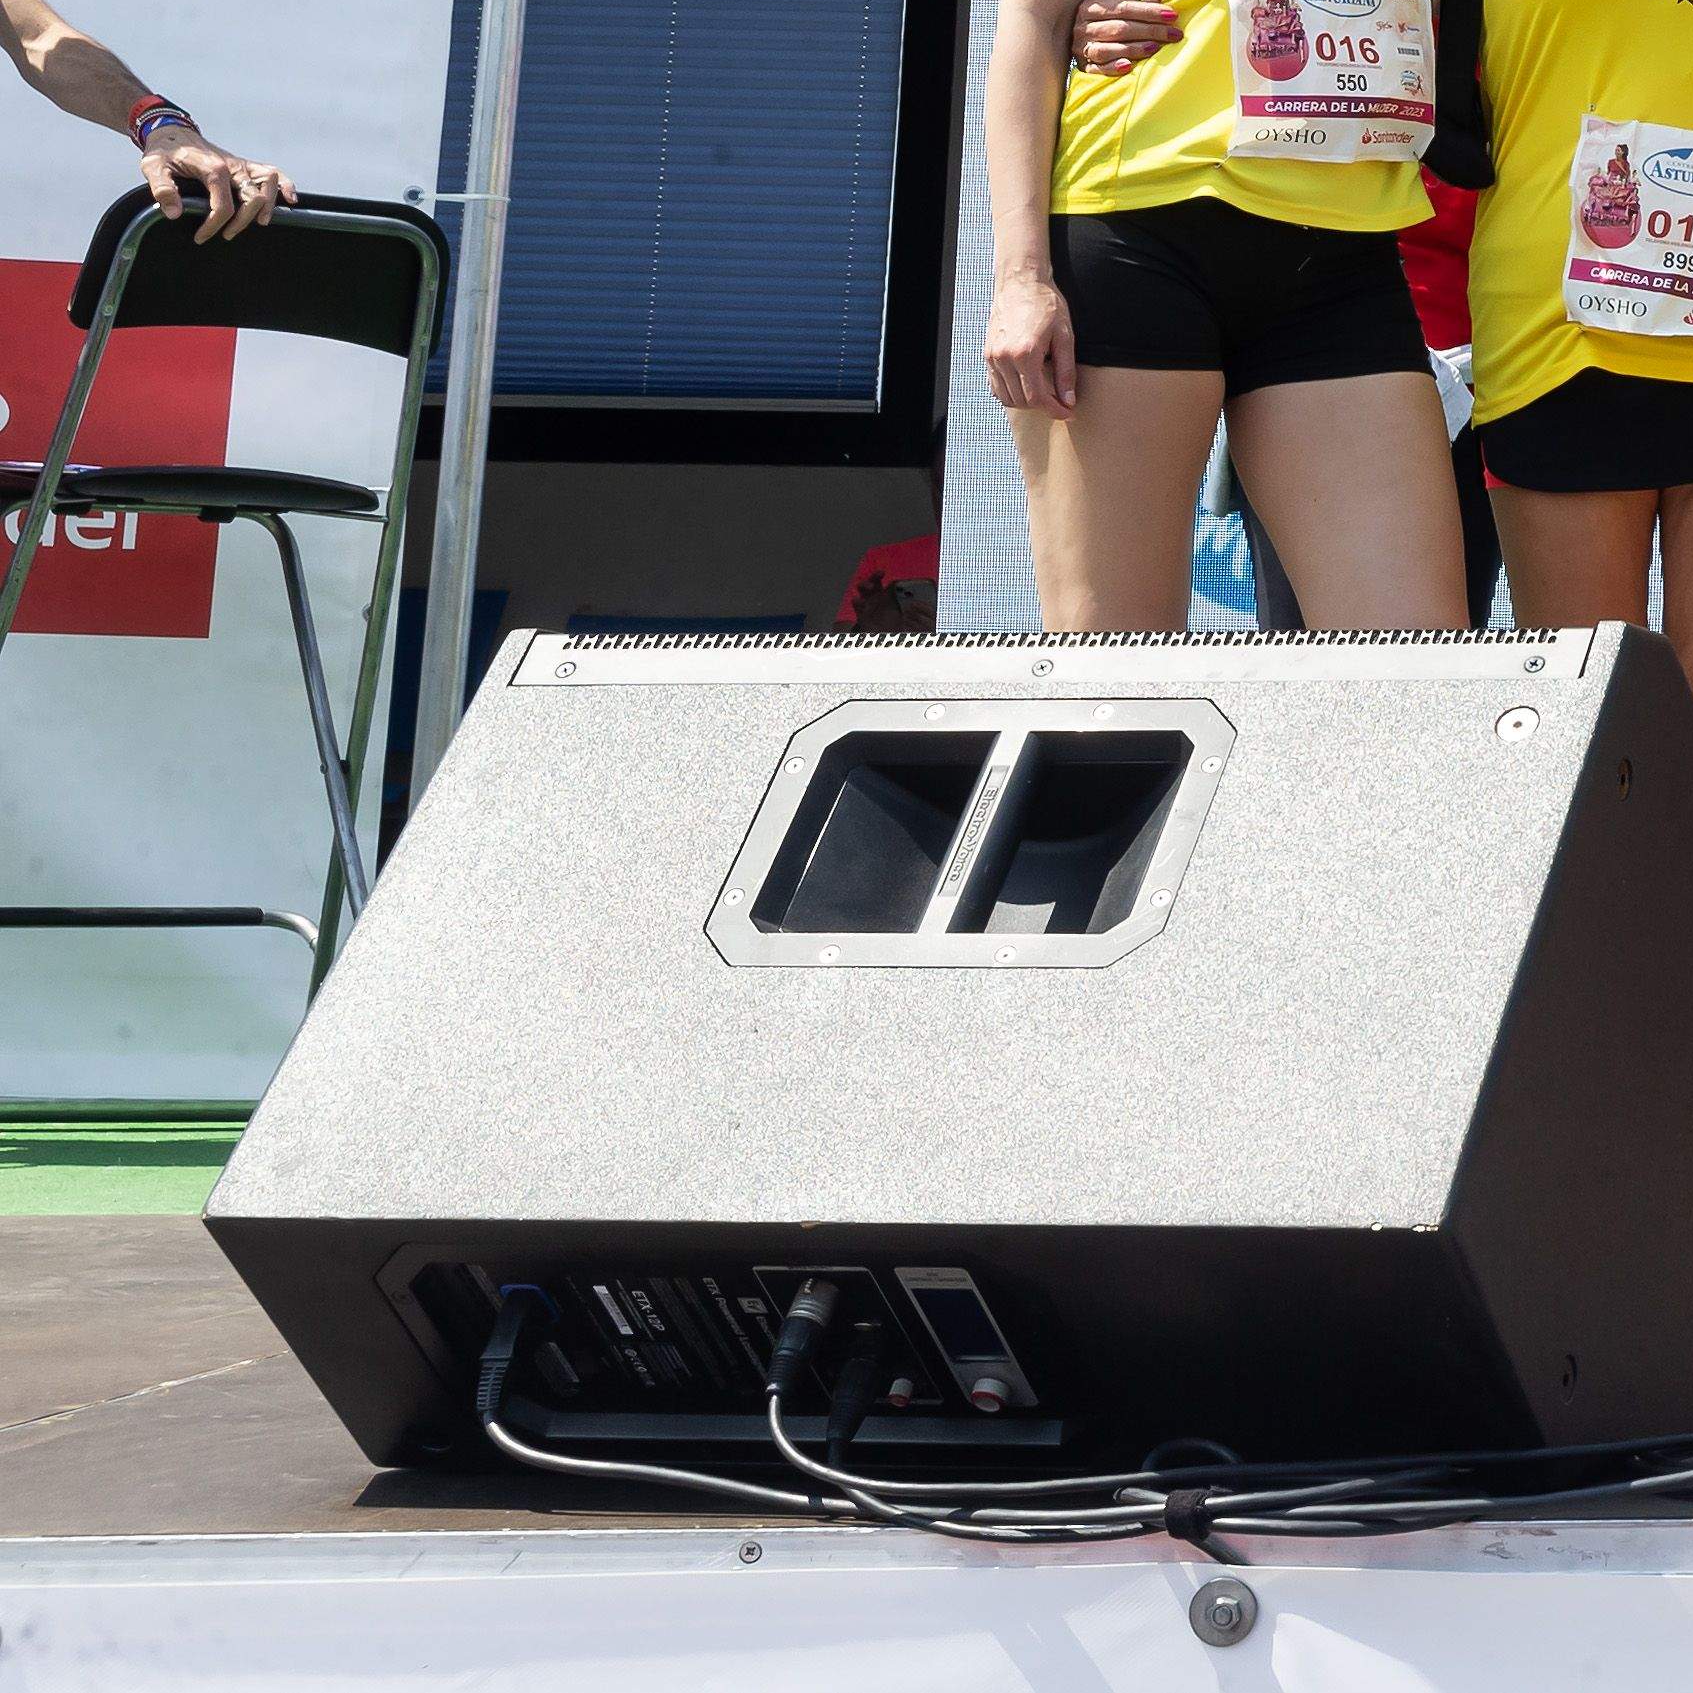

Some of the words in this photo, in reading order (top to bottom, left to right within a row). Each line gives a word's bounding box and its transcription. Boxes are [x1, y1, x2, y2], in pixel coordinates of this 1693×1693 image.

[1315, 32, 1380, 64] 016
[1337, 74, 1368, 91] 550
[1265, 101, 1328, 113] CARRERA
[1330, 102, 1348, 113] DE
[1350, 102, 1366, 113] LA
[1255, 128, 1327, 145] OYSHO
[1590, 266, 1649, 286] CARRERA
[1652, 277, 1672, 289] DE
[1674, 280, 1689, 293] LA
[1579, 294, 1647, 317] OYSHO
